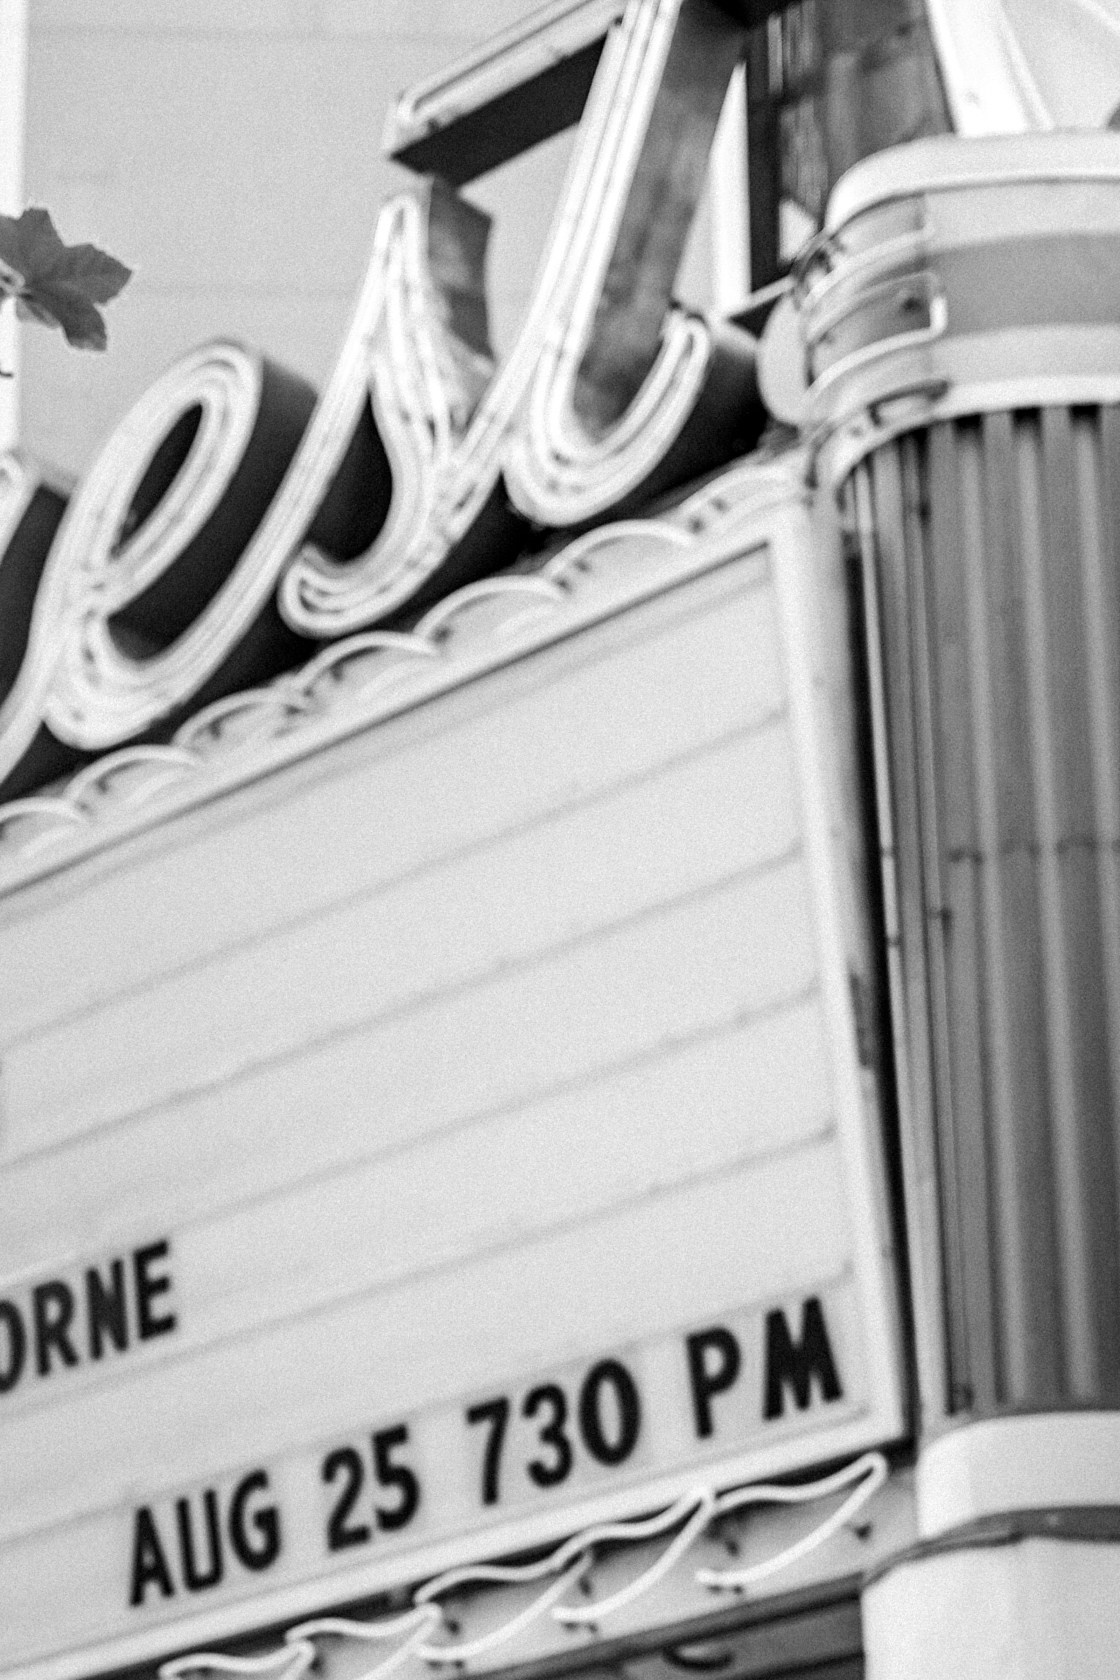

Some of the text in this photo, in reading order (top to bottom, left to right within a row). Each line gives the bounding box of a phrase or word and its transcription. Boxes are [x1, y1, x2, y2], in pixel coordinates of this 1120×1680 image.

[127, 1467, 284, 1609] AUG
[320, 1422, 422, 1554] 25
[464, 1356, 644, 1508] 730
